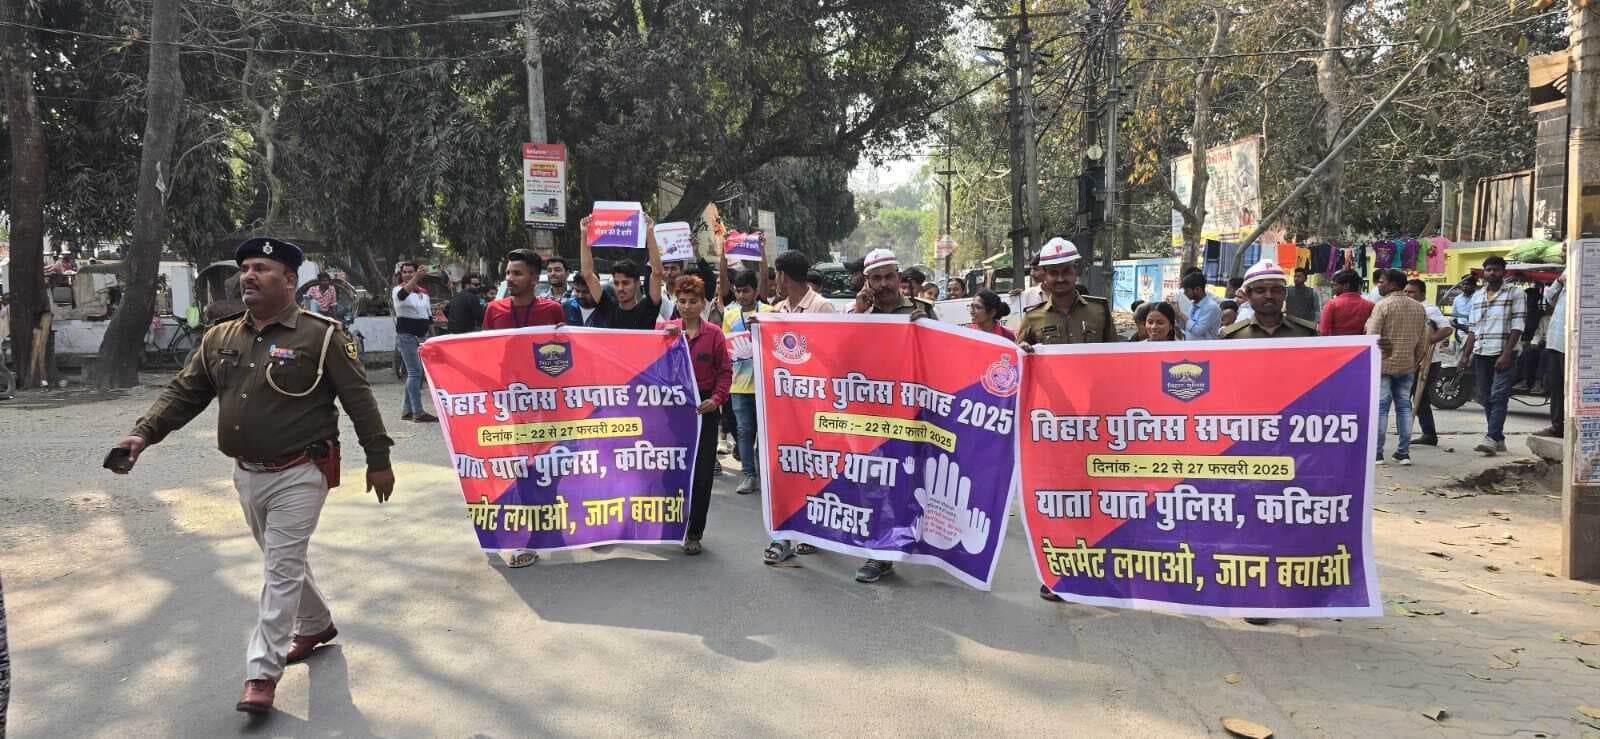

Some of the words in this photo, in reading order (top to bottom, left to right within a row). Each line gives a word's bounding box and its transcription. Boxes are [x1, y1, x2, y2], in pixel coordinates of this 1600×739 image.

[493, 383, 557, 420] पुलिस
[563, 385, 630, 408] सप्ताह
[636, 385, 687, 406] 2025
[774, 368, 827, 399] बिहार
[832, 373, 895, 409] पुलिस
[957, 398, 1014, 435] 2025
[482, 429, 512, 443] दिनांक
[531, 430, 545, 438] 22
[548, 425, 557, 438] से
[560, 427, 573, 437] 27
[576, 422, 608, 435] फरवरी
[611, 423, 638, 433] 2025
[819, 416, 848, 430] दिनांक
[865, 423, 878, 432] 22
[882, 421, 890, 434] से
[893, 425, 902, 435] 27
[930, 431, 952, 447] 2025
[1030, 409, 1100, 441] बिहार
[1106, 408, 1187, 450] पुलिस
[1194, 415, 1282, 441] सप्ताह
[1289, 414, 1358, 443] 2025
[489, 456, 528, 479] यात
[534, 446, 607, 487] पुलिस,
[614, 440, 687, 471] कटिहार
[778, 440, 840, 480] साईबर
[844, 453, 899, 487] थाना
[1093, 458, 1130, 473] दिनांक
[1152, 463, 1168, 473] 22
[1172, 460, 1183, 474] से
[1187, 463, 1203, 474] 27
[1208, 460, 1248, 475] फरवरी
[1253, 464, 1289, 475] 2025
[504, 495, 577, 535] लगाओ,
[583, 497, 625, 526] जान
[629, 488, 685, 523] बचाओ
[806, 492, 874, 537] कटिहार
[1036, 490, 1092, 517] याता
[1097, 491, 1148, 519] यात
[1155, 484, 1245, 530] पुलिस,
[1255, 487, 1352, 524] कटिहार
[1042, 537, 1106, 578] हेलमेट
[1111, 542, 1204, 591] लगाओ,
[1213, 553, 1269, 588] जान
[1276, 544, 1351, 586] बचाओ
